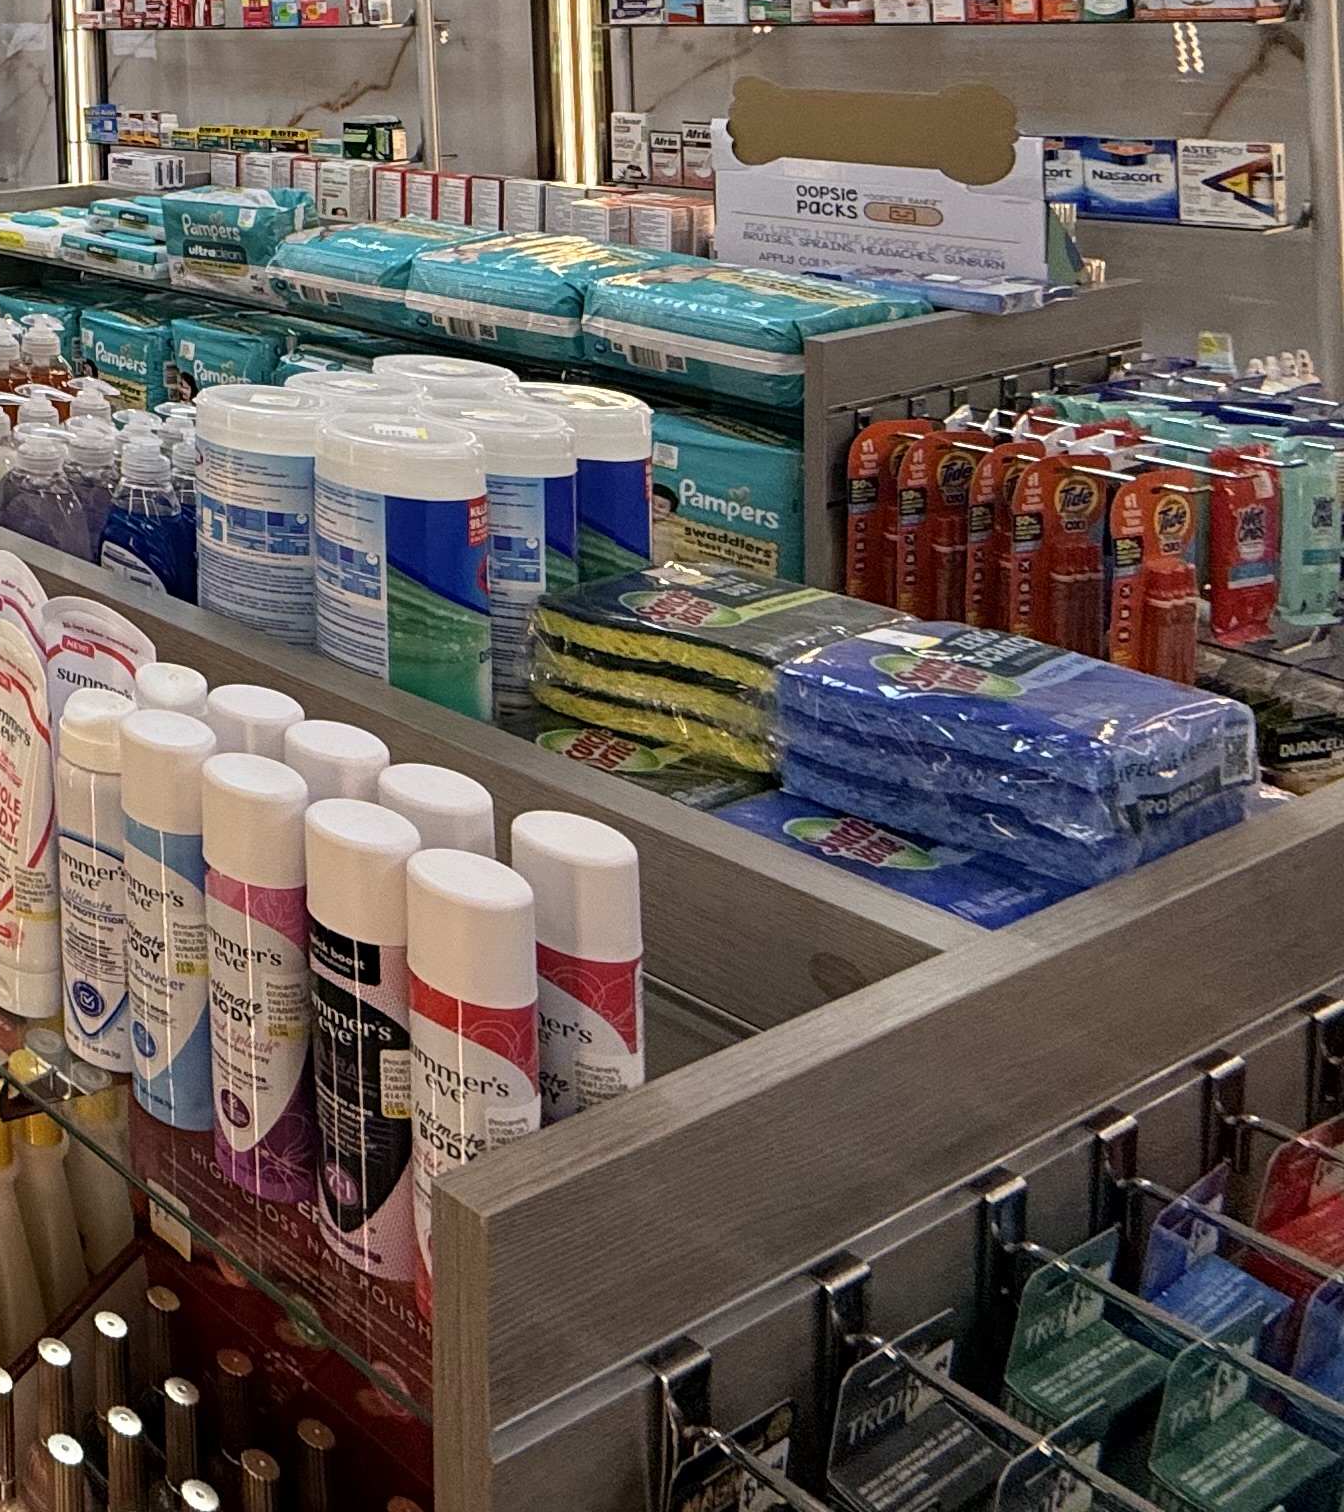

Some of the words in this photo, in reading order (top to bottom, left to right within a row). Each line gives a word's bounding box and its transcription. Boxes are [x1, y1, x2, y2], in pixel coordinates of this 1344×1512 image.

[270, 130, 299, 138] BAYER
[653, 135, 678, 147] Afrin
[1092, 168, 1162, 183] Nasacort
[181, 213, 241, 242] Pampers
[188, 245, 243, 262] ultraclean
[743, 231, 794, 248] BRUISES,
[798, 237, 857, 254] SPRAINS,
[861, 245, 939, 263] HEADACHES,
[945, 254, 1005, 271] SUNBURN
[758, 252, 796, 265] APPLY
[95, 342, 147, 375] Pampers
[941, 462, 972, 482] Tide
[679, 478, 780, 530] Pampers
[1061, 487, 1094, 506] Tide
[1158, 509, 1187, 530] Tide
[684, 525, 773, 559] swaddlers
[696, 538, 720, 555] best
[724, 545, 770, 568] dryness
[66, 640, 89, 653] NEW!
[1, 725, 17, 744] eve
[70, 872, 98, 891] eve
[73, 904, 125, 925] PROTECTION
[215, 947, 246, 973] eve
[318, 1015, 351, 1046] eve
[425, 1074, 464, 1104] eve
[415, 1100, 487, 1152] Intimate
[419, 1122, 478, 1162] BODY
[242, 1189, 299, 1239] GLOSS
[307, 1235, 352, 1280] NAIL
[359, 1277, 431, 1339] POLISH
